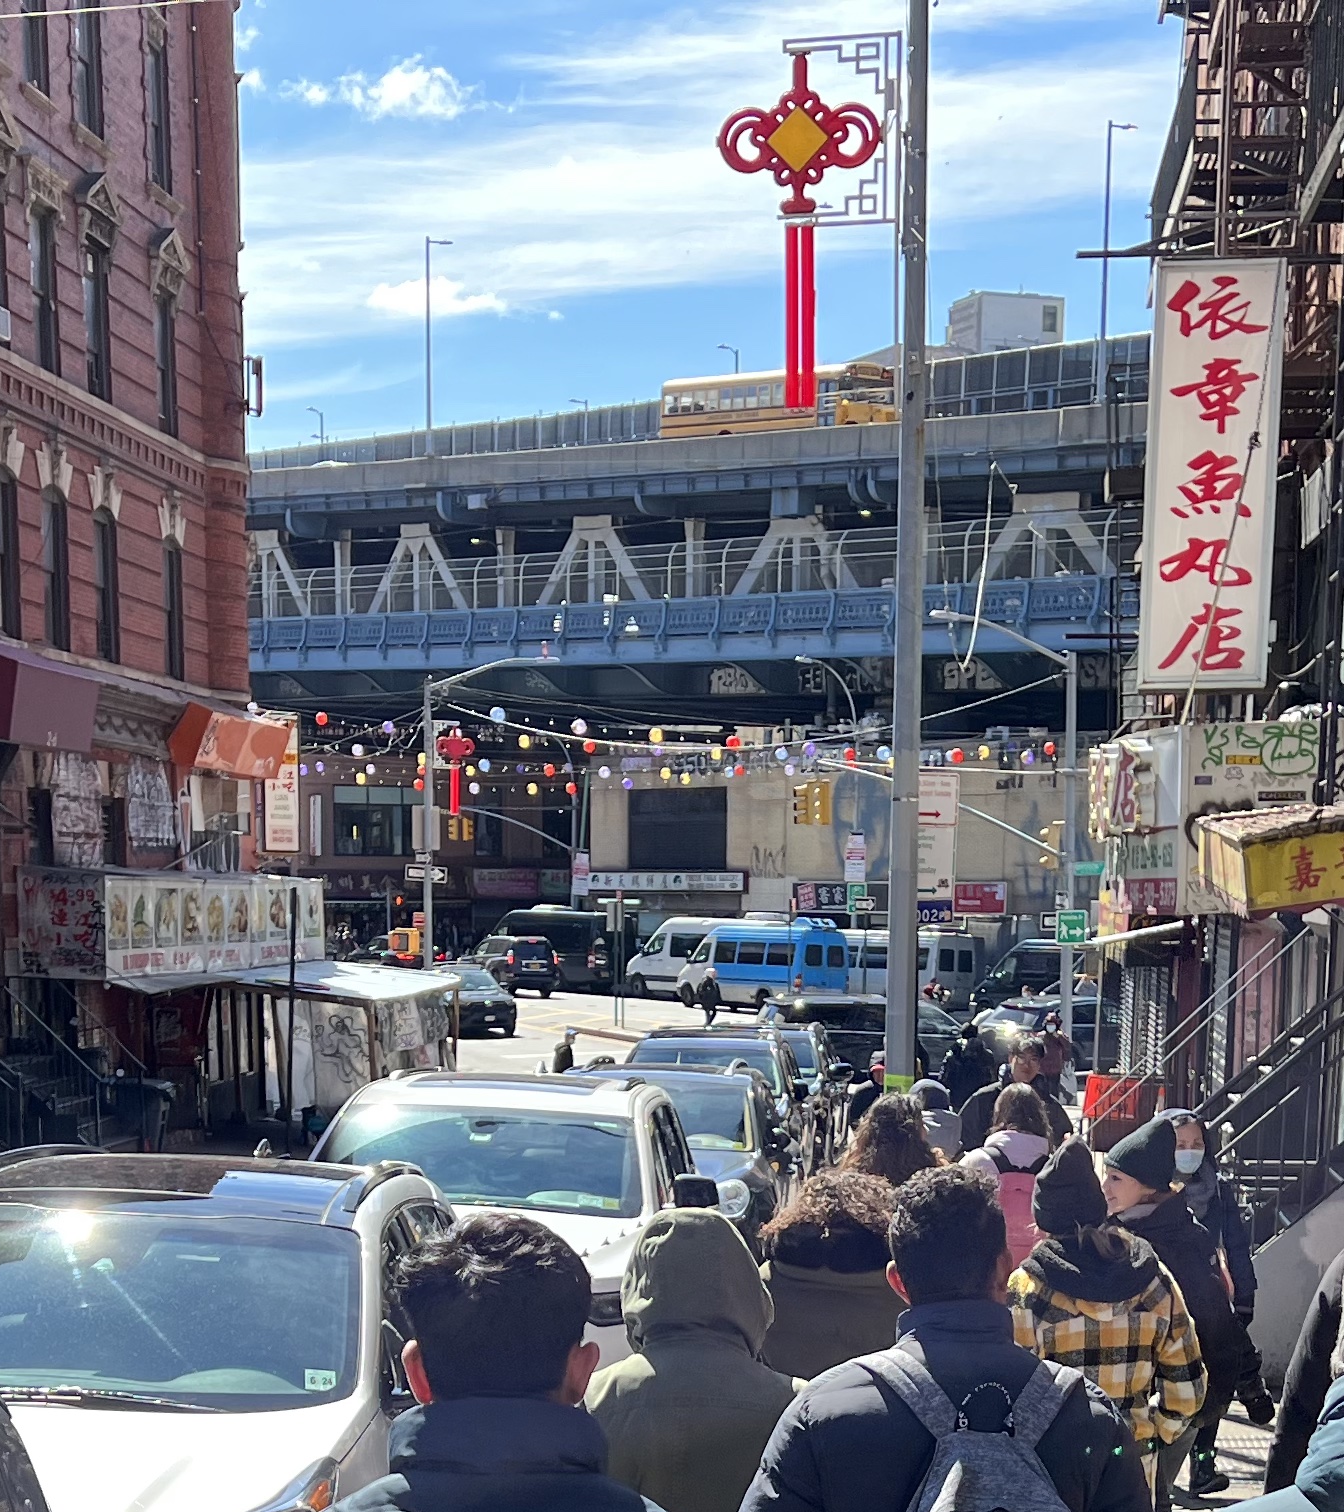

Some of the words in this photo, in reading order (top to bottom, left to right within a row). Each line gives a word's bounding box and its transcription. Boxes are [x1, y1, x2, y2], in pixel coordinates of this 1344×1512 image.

[1157, 275, 1269, 672] 依章魚丸店
